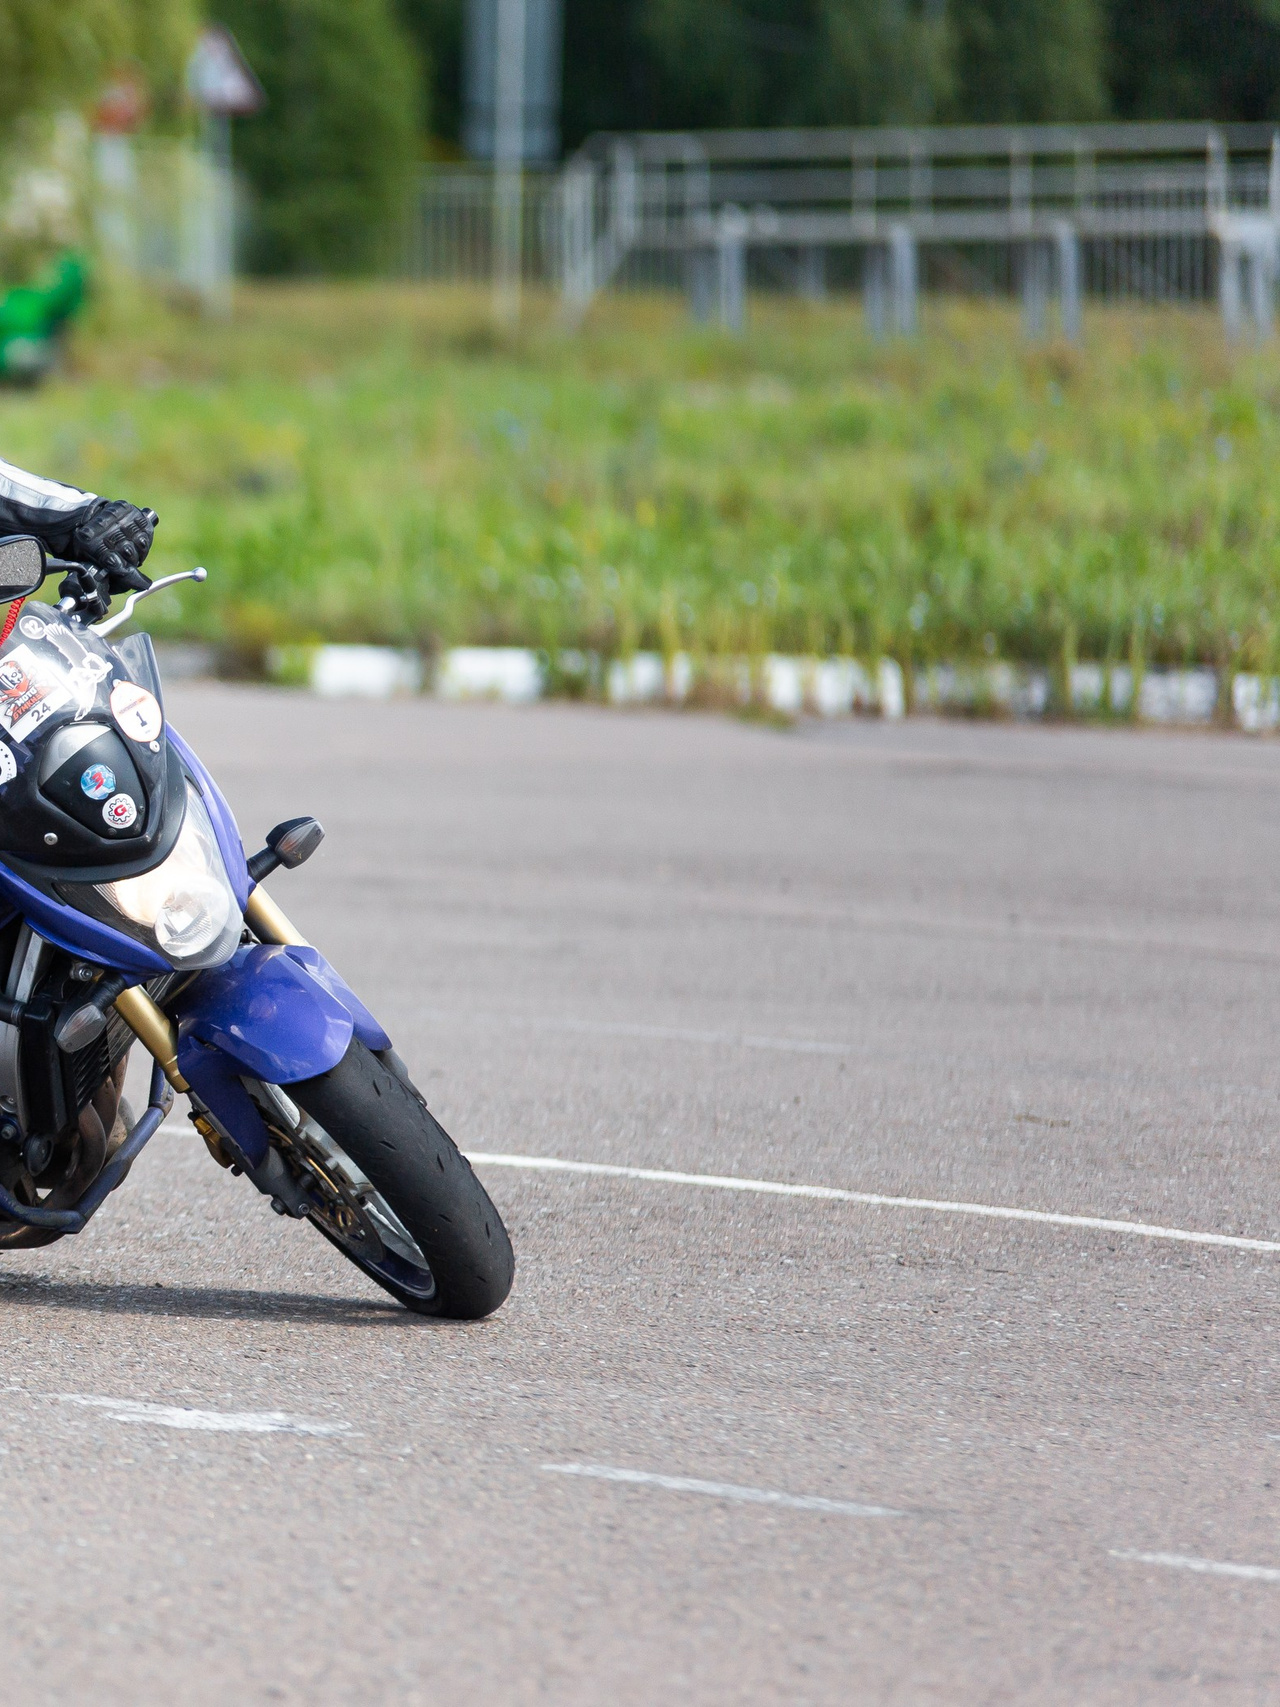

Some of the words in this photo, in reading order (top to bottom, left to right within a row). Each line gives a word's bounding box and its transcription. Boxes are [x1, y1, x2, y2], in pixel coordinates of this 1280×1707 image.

[13, 684, 49, 721] GYMKHA
[31, 702, 51, 722] 24
[136, 711, 147, 727] 1
